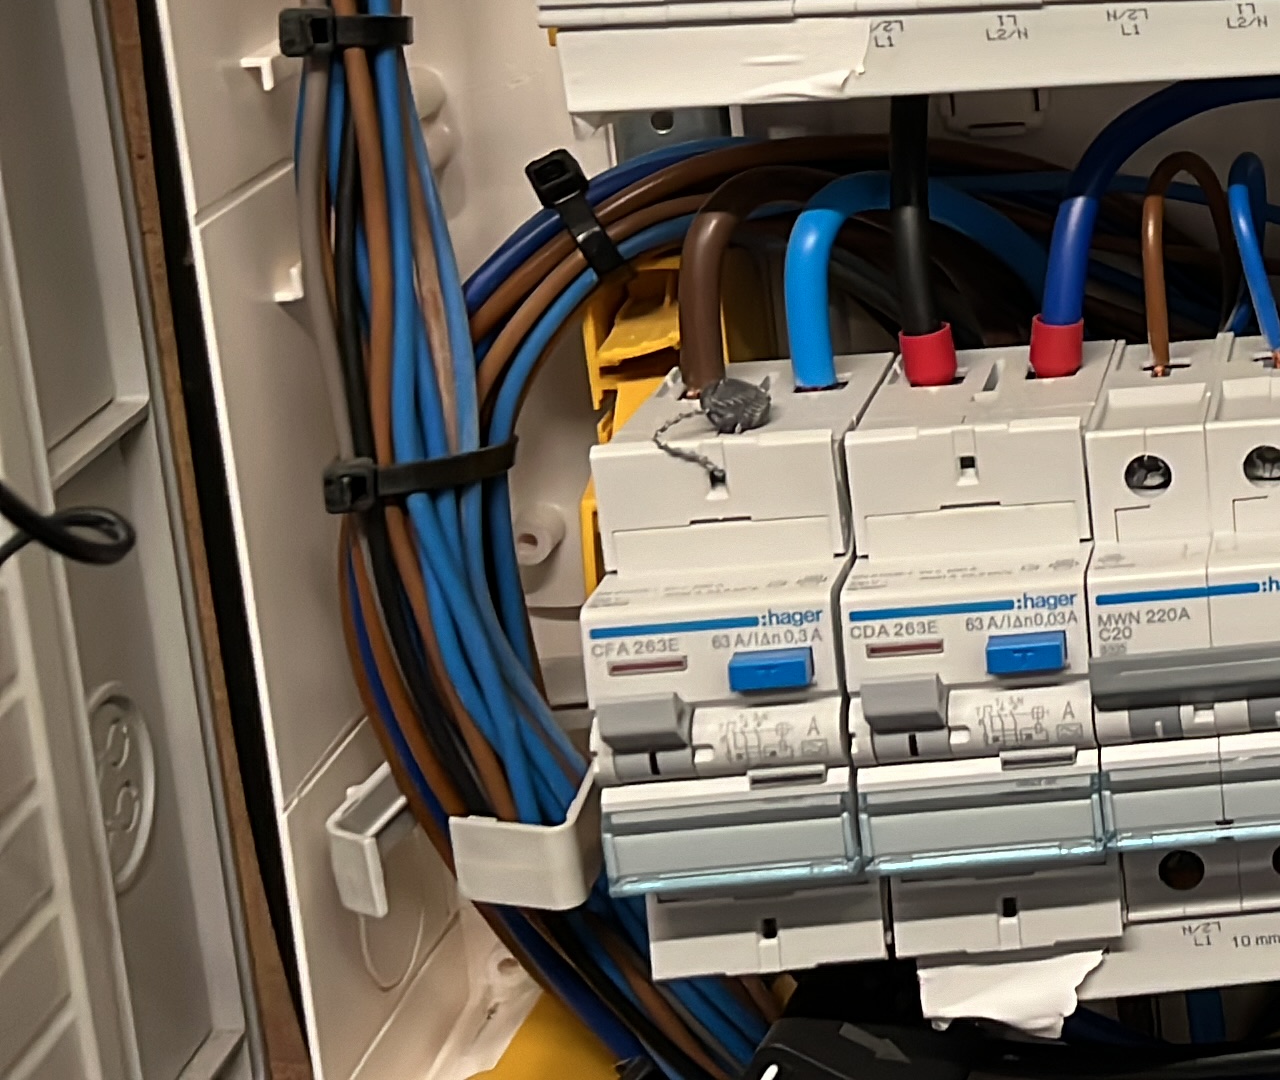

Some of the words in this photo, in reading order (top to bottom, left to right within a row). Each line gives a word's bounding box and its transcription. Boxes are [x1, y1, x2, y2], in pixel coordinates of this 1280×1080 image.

[1097, 610, 1143, 628] MWN
[1145, 607, 1191, 623] 220A
[850, 623, 888, 640] CDA
[892, 619, 939, 636] 263E
[1099, 626, 1132, 641] C20
[591, 641, 630, 658] CFA
[633, 637, 680, 654] 263E
[1231, 933, 1250, 948] 10
